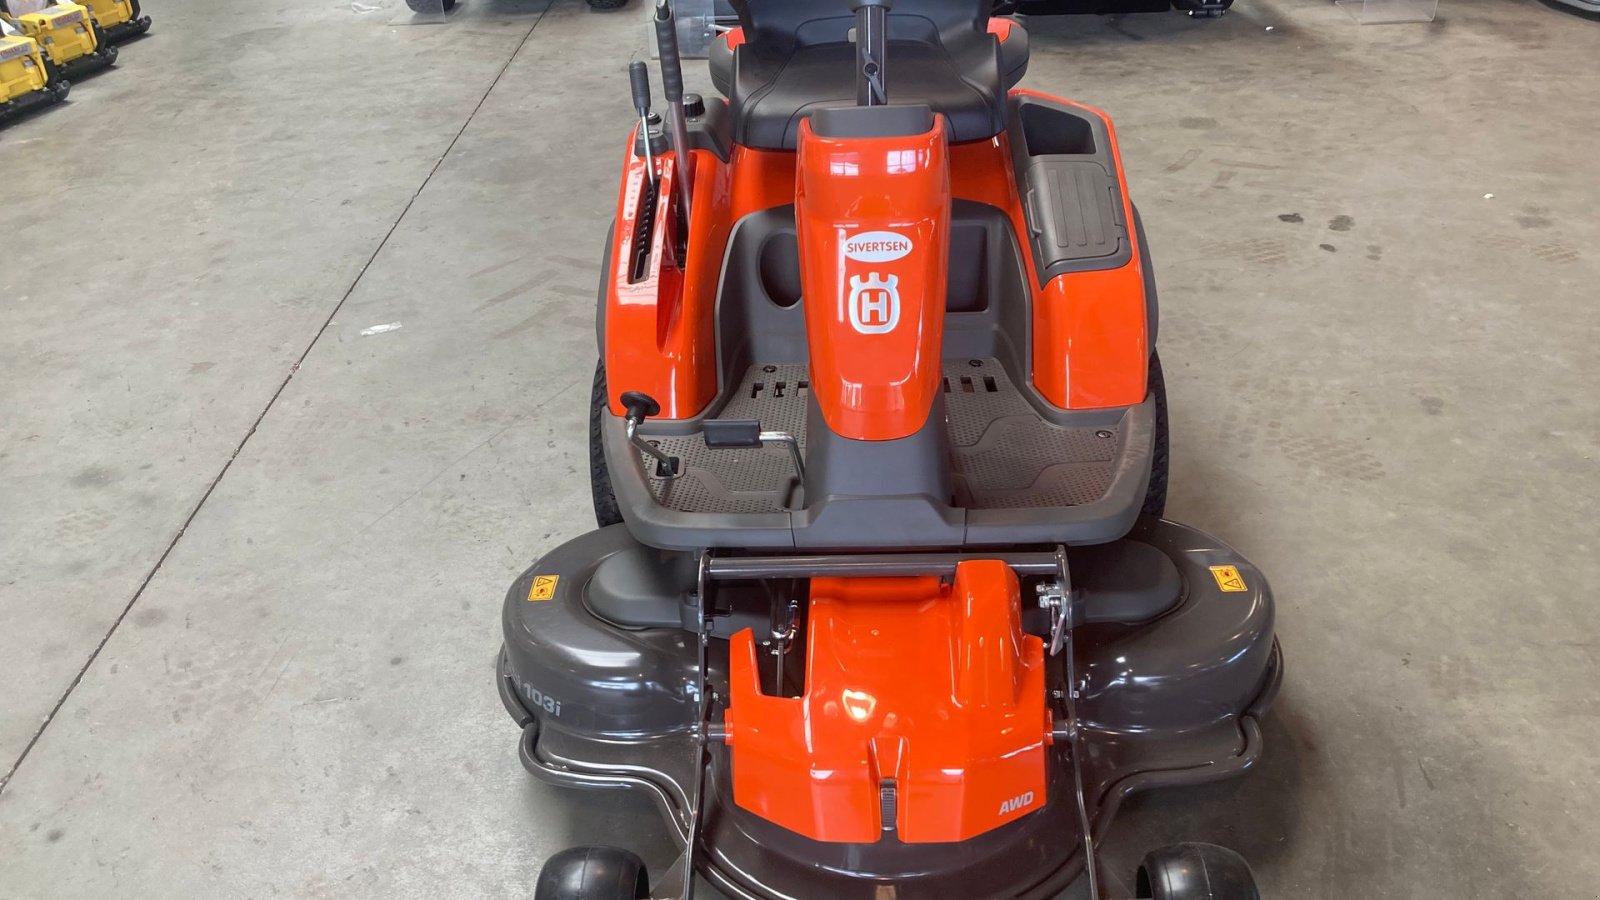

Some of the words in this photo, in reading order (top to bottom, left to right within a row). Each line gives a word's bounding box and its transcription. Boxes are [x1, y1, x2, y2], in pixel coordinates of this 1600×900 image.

[847, 241, 908, 253] SIVERTSEN
[862, 291, 887, 323] H
[523, 682, 561, 717] 103i
[998, 790, 1034, 816] AWD
